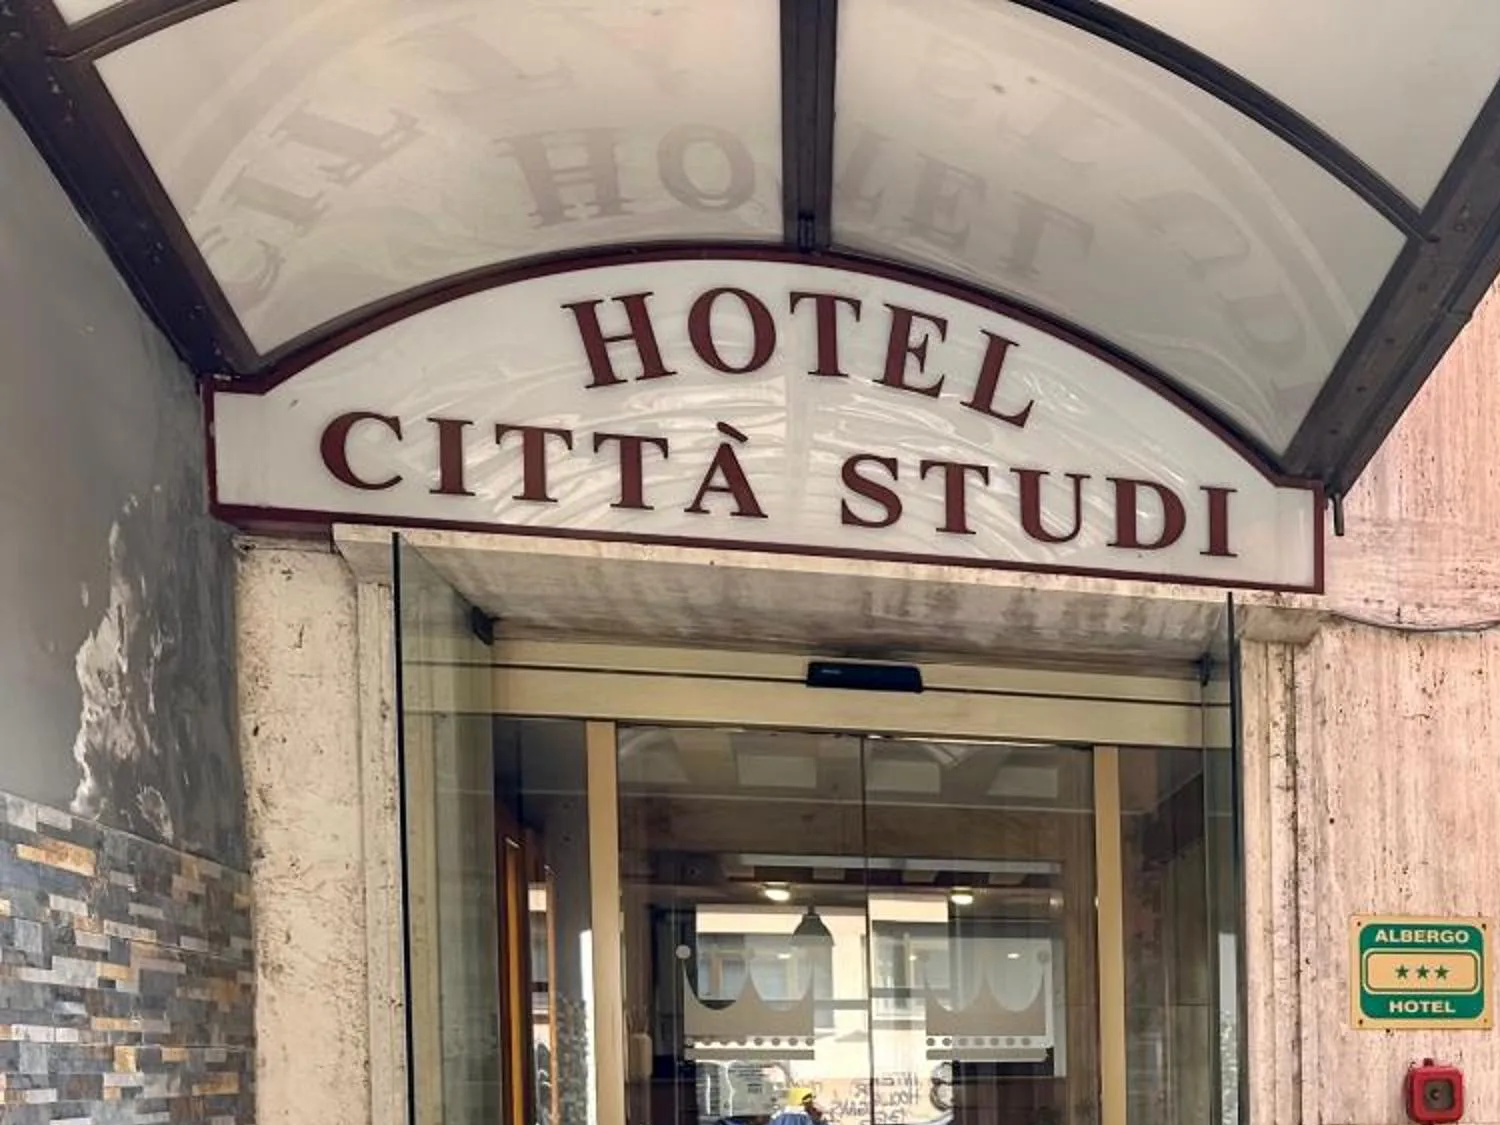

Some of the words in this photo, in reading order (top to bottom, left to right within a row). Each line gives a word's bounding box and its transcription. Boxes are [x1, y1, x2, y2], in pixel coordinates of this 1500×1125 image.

[561, 285, 1041, 428] HOTEL
[319, 411, 769, 520] CITTÀ
[840, 452, 1239, 559] STUDI
[1374, 929, 1470, 944] ALBERGO
[1388, 999, 1457, 1014] HOTEL
